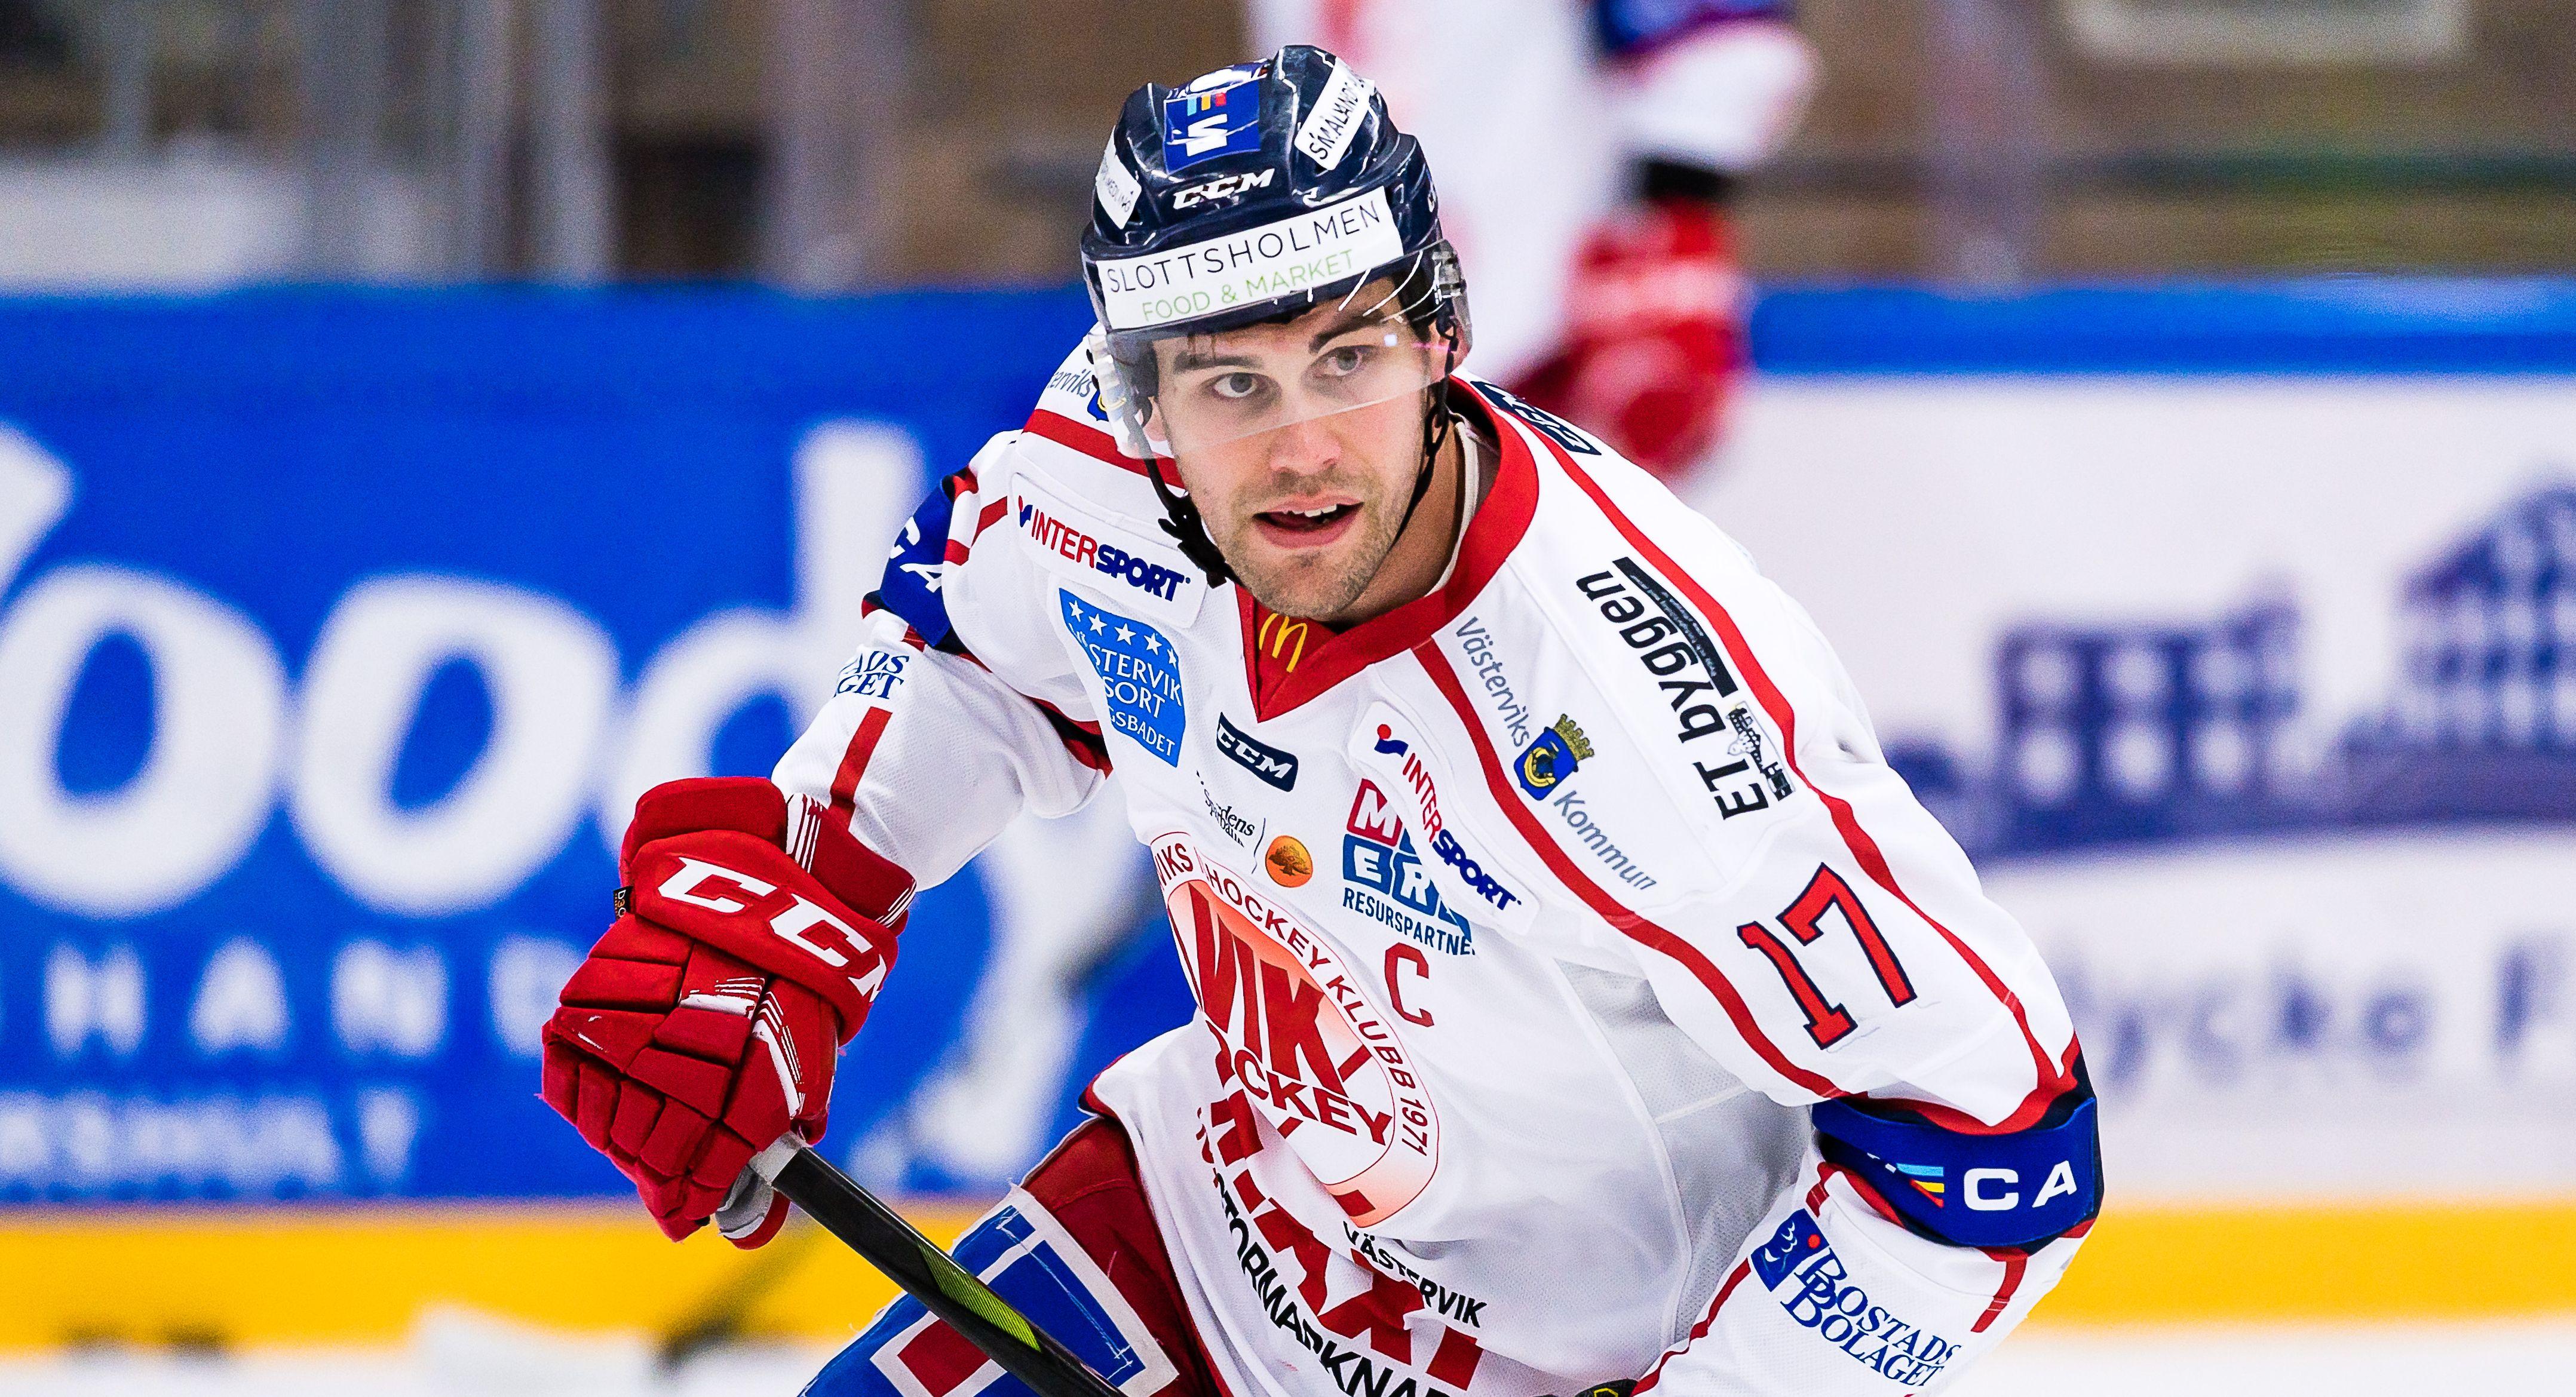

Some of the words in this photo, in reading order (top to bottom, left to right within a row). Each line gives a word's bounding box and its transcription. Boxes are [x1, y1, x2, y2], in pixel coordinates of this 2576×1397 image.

[1173, 168, 1275, 210] CCM
[1107, 200, 1380, 293] SLOTTSHOLMEN
[1142, 291, 1210, 322] FOOD
[1220, 284, 1239, 304] &
[1246, 248, 1353, 297] MARKET
[1048, 369, 1093, 398] erviks
[1031, 508, 1185, 602] INTERSPORT
[1455, 616, 1529, 747] Västerviks
[1575, 570, 1726, 744] byggen
[1218, 723, 1293, 779] CCM
[1691, 758, 1769, 820] ET
[1402, 752, 1517, 911] INTERSPORT
[1553, 790, 1657, 891] Kommun
[1342, 887, 1475, 956] RESURSPARTNE
[1737, 862, 1918, 1050] 17
[1385, 941, 1435, 1028] C
[1326, 975, 1417, 1090] KLUBB
[1399, 1097, 1428, 1157] 1971
[1780, 1273, 1945, 1387] BOLAGET
[1793, 1247, 1962, 1365] BOSTADS
